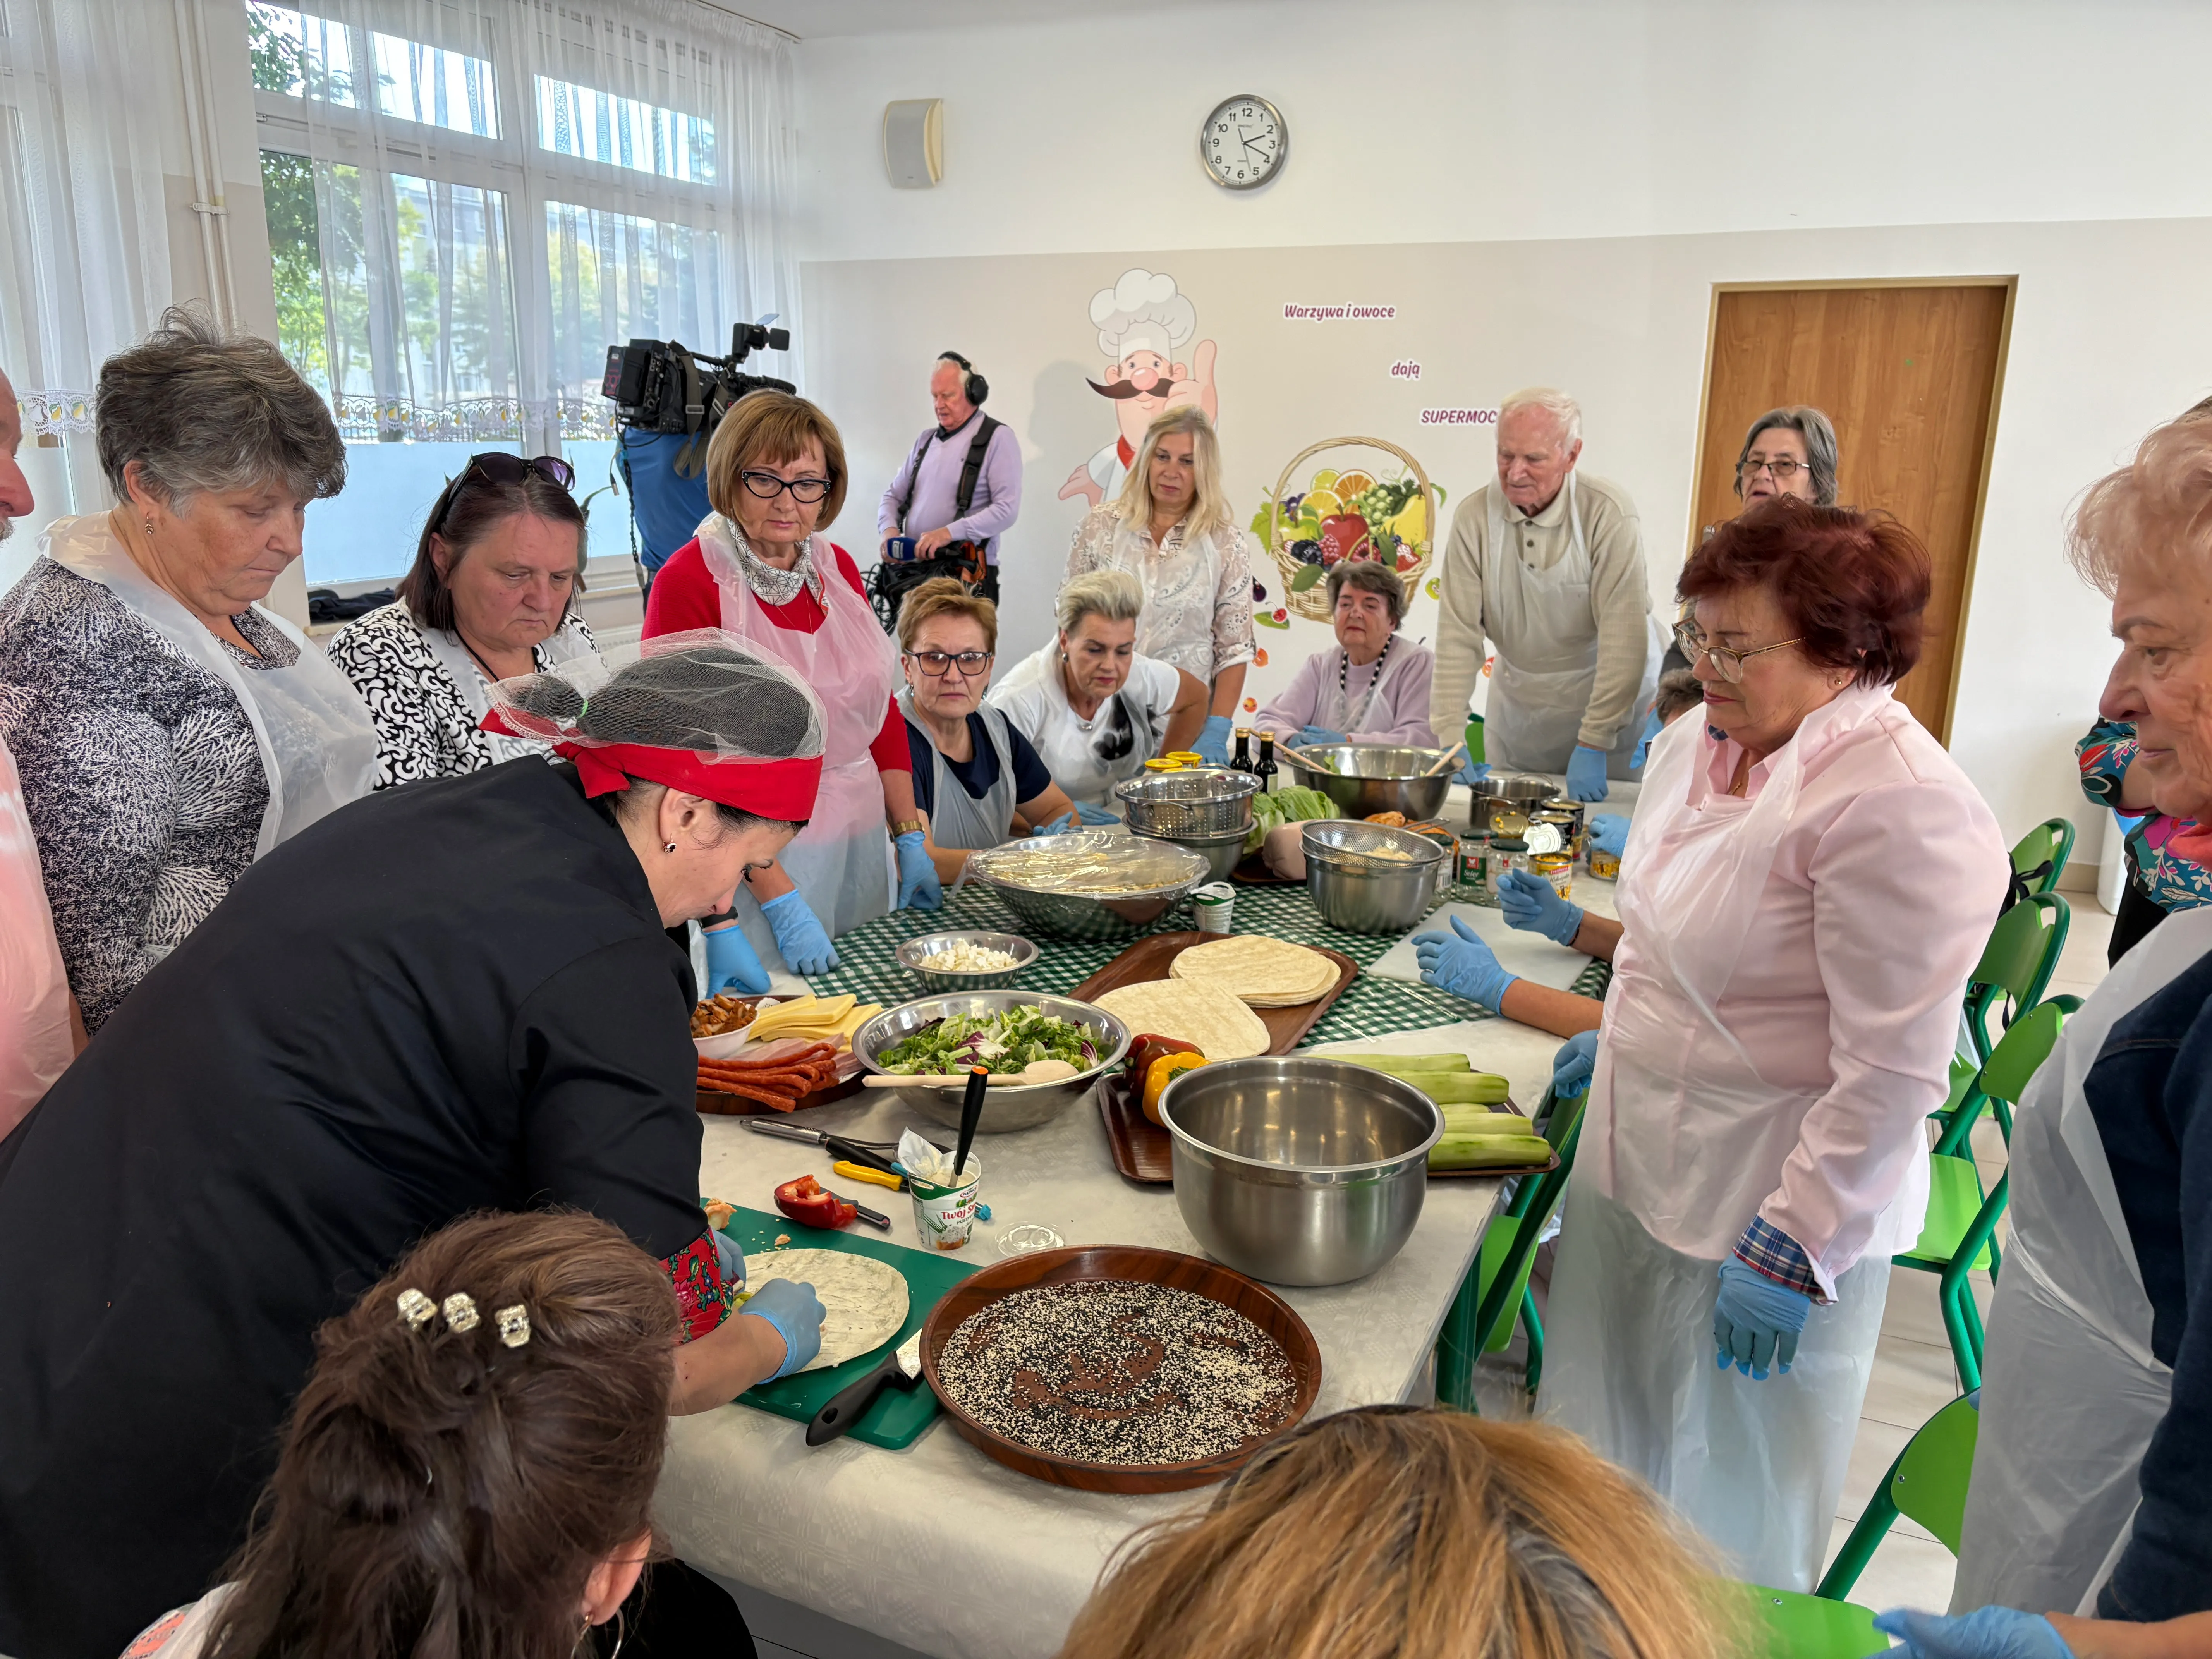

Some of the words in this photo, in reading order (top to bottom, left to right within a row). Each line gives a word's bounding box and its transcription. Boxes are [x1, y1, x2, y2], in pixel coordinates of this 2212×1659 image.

[1228, 112, 1236, 122] 11
[1242, 108, 1253, 117] 12
[1259, 113, 1264, 122] 1
[1218, 124, 1228, 132] 10
[1266, 125, 1274, 134] 2
[1212, 138, 1220, 147] 9
[1269, 140, 1276, 149] 3
[1214, 155, 1222, 164] 8
[1263, 155, 1270, 164] 4
[1224, 166, 1231, 175] 7
[1237, 170, 1245, 179] 6
[1252, 167, 1260, 175] 5
[1284, 304, 1343, 321] Warzywa
[1346, 303, 1352, 318] i
[1352, 306, 1395, 318] owoce
[1391, 361, 1420, 379] dają
[1421, 410, 1498, 424] SUPERMOC
[941, 1206, 966, 1220] Twój
